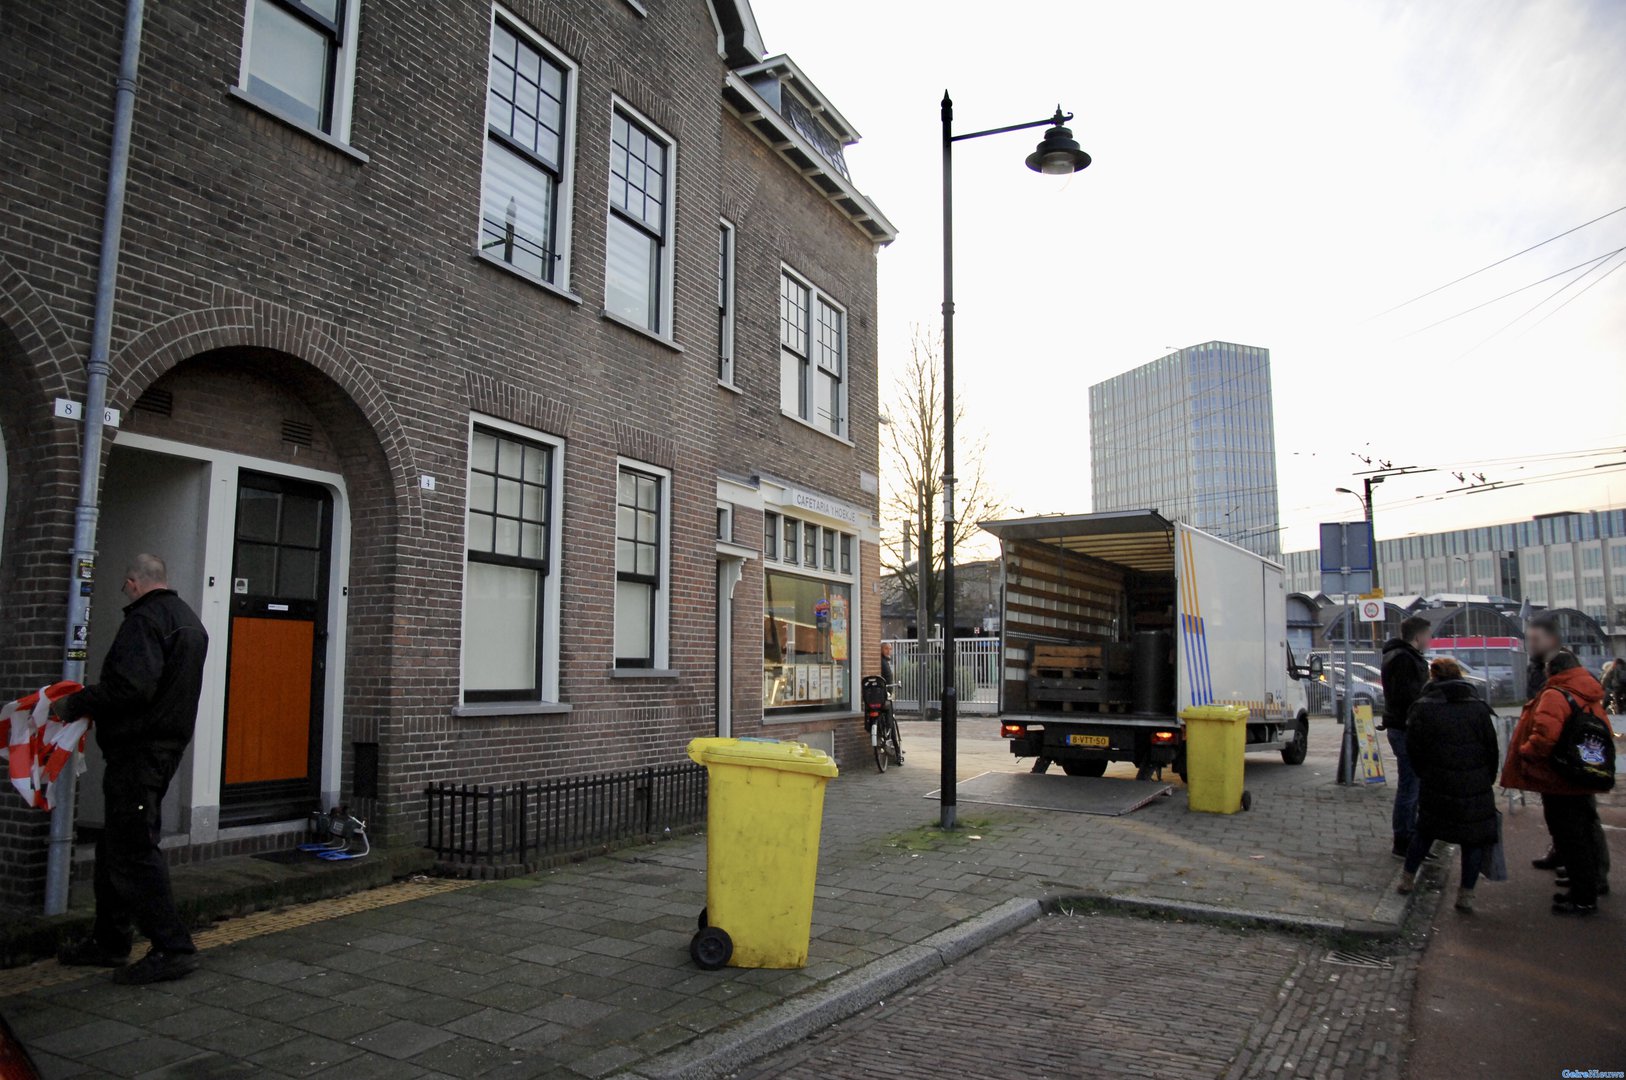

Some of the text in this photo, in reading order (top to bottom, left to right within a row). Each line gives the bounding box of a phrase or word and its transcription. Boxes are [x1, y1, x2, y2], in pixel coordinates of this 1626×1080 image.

[64, 404, 73, 415] 8
[104, 411, 111, 422] 6
[425, 479, 430, 488] 4
[796, 494, 829, 514] CAFETARIA
